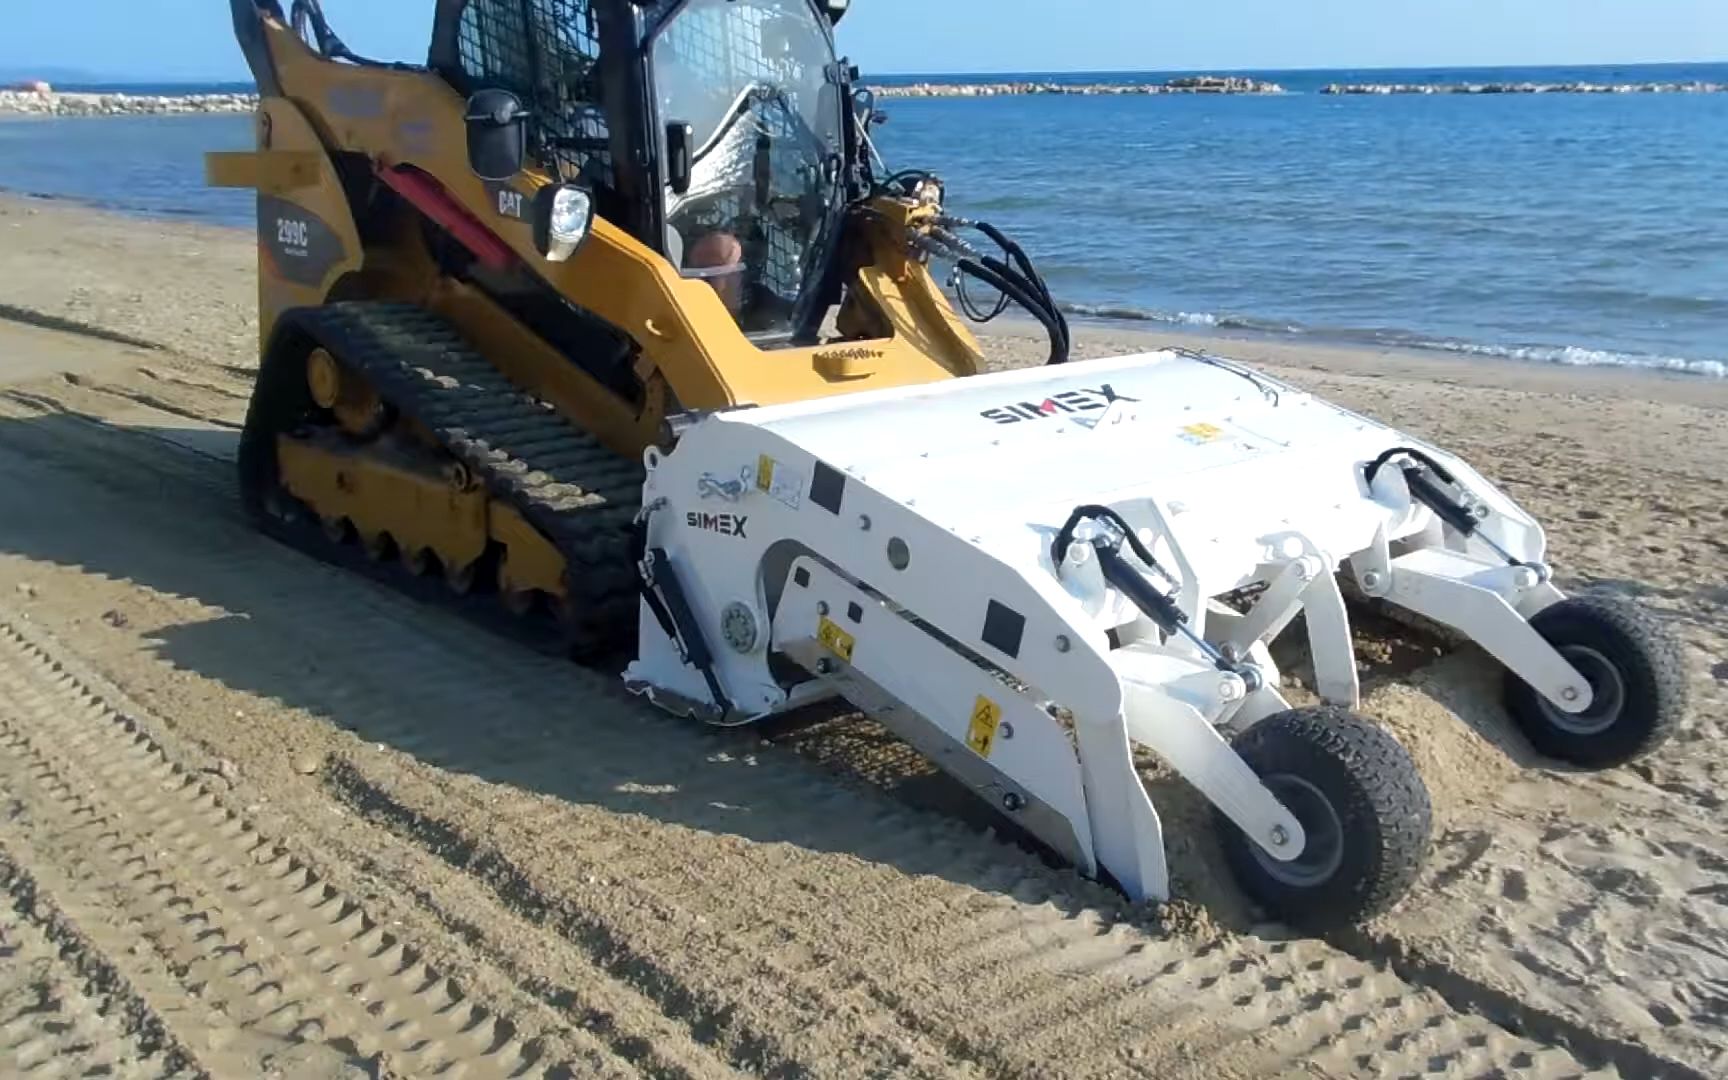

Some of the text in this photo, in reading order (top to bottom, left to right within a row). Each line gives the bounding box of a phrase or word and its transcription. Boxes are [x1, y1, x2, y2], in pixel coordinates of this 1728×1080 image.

[499, 190, 523, 218] CAT
[980, 383, 1142, 424] SIMEX
[686, 511, 748, 539] SIMEX
